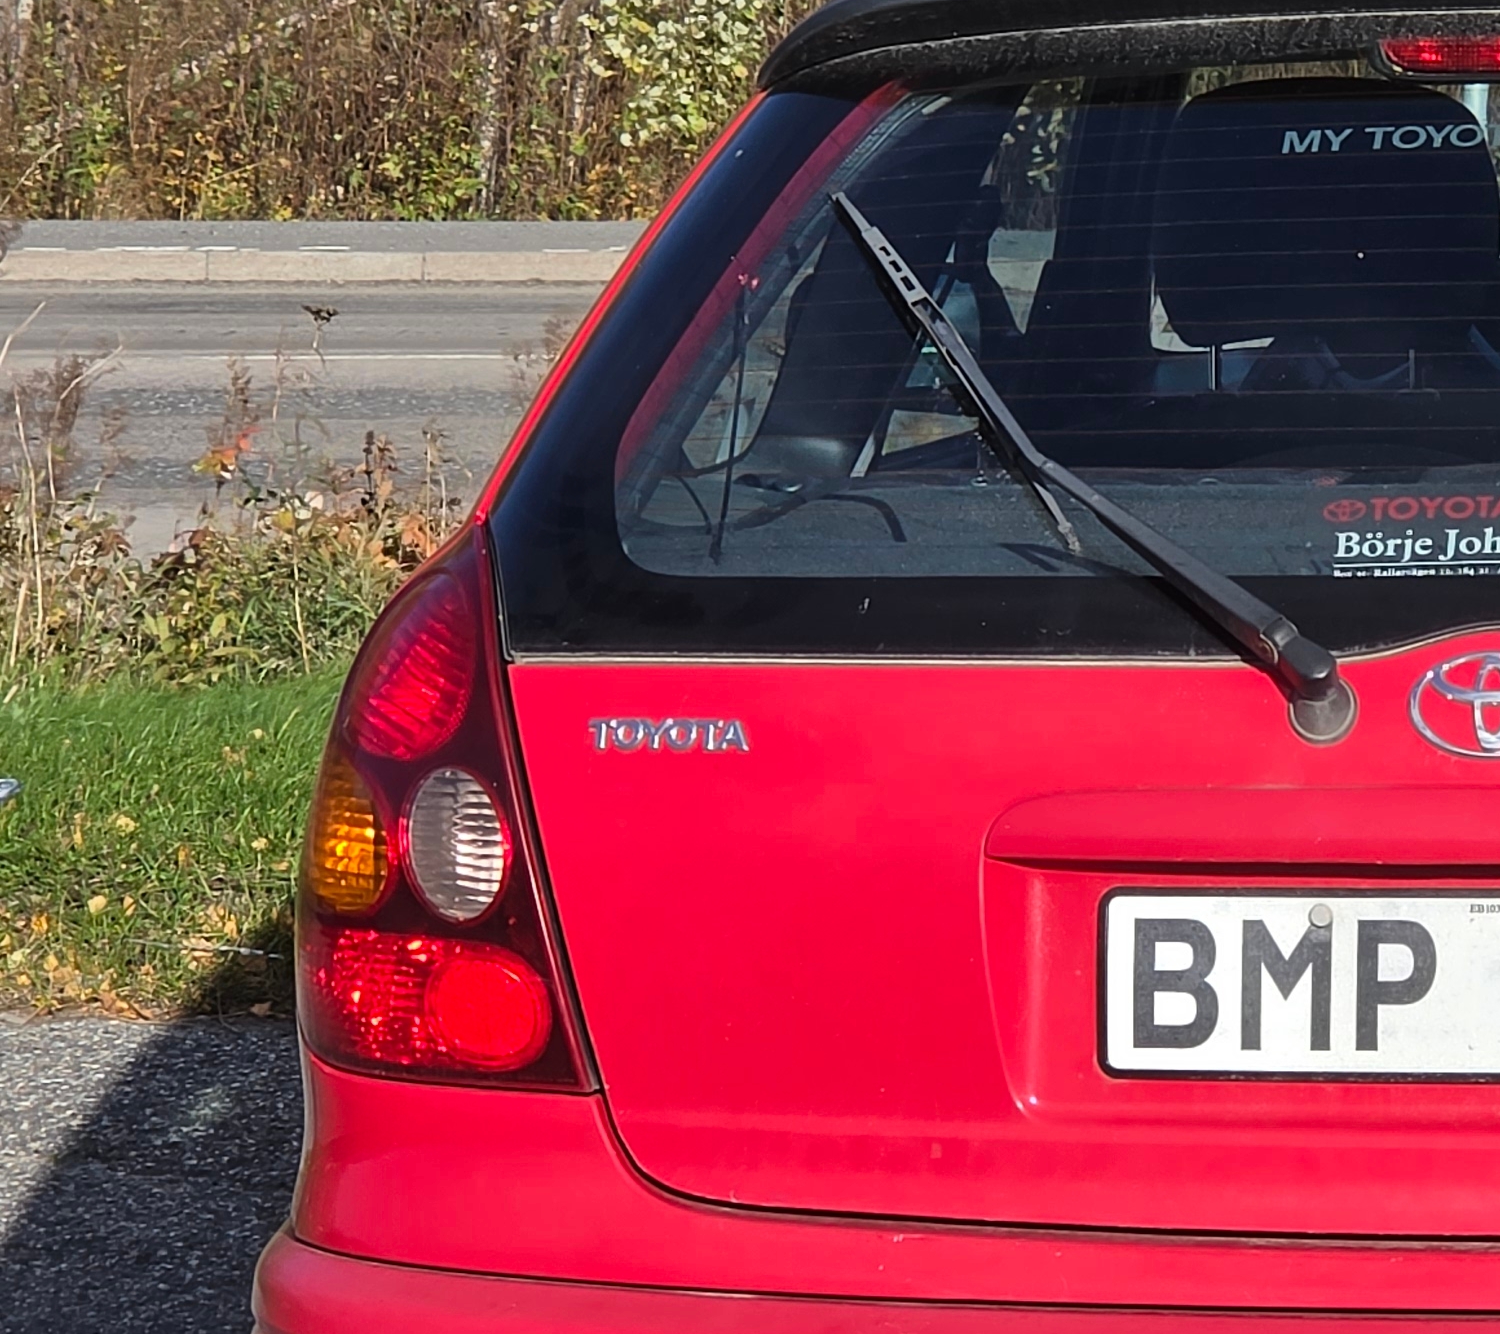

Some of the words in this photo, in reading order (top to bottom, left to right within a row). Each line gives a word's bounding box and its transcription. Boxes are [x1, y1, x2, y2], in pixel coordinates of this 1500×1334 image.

[1282, 128, 1353, 154] MY
[1333, 529, 1433, 562] Börje
[588, 717, 750, 751] TOYOTA
[1133, 917, 1437, 1052] BMP
